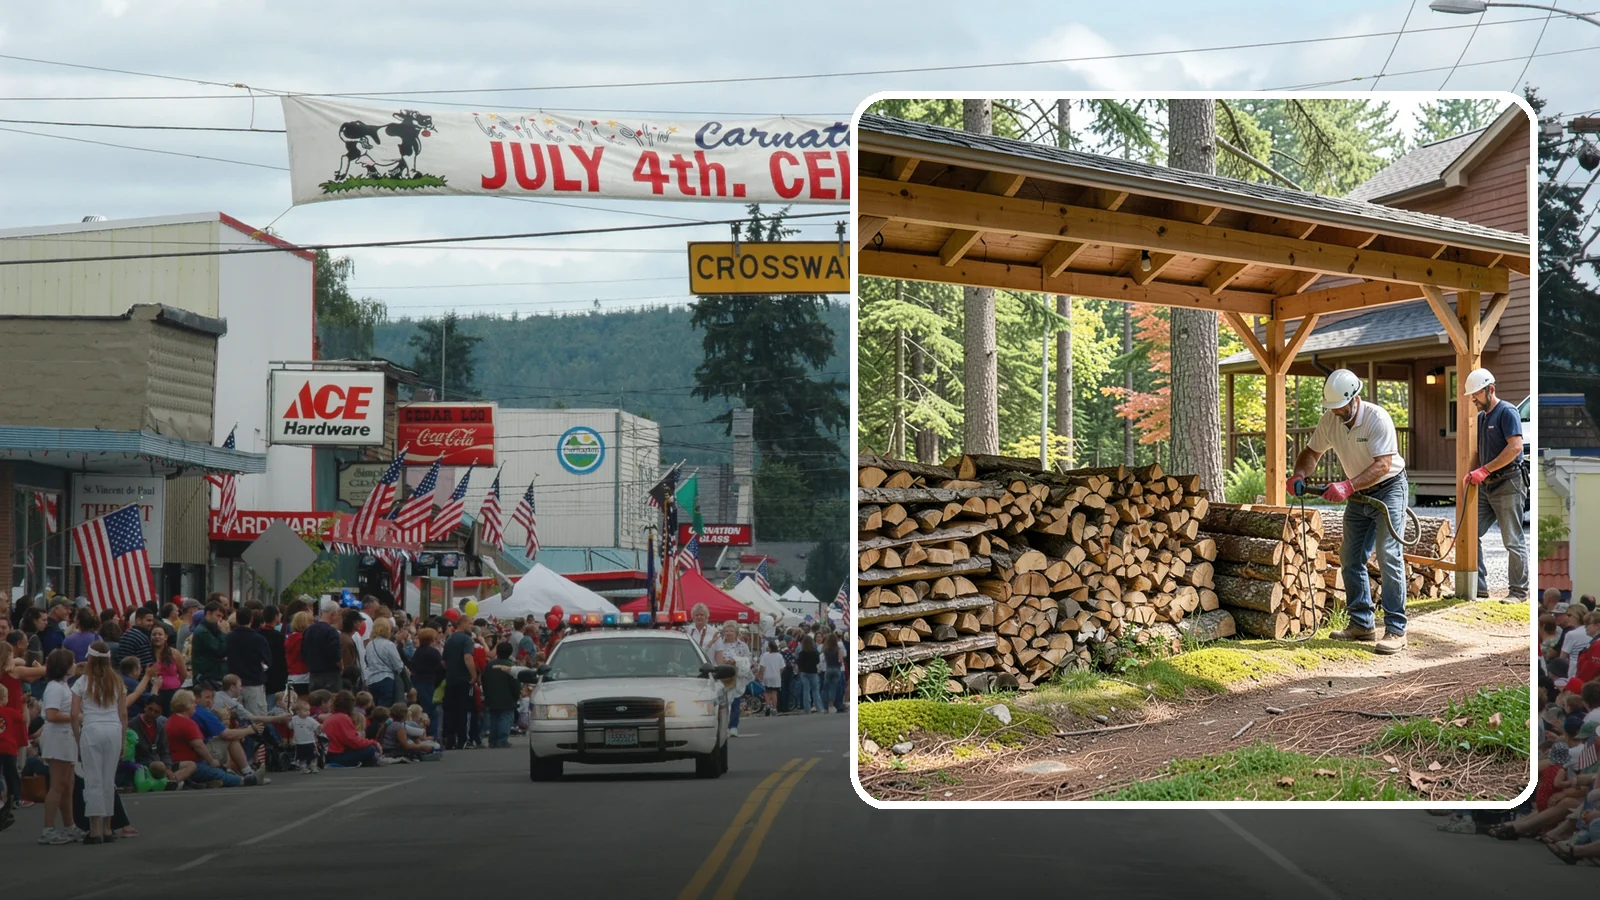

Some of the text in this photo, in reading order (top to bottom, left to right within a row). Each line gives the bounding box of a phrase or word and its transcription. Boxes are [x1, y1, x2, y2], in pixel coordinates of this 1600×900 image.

[481, 141, 605, 193] JULY
[632, 150, 747, 198] 4th.
[697, 254, 850, 280] CROSSWA
[283, 380, 373, 420] ACE
[406, 409, 453, 422] CEDAR
[283, 421, 371, 436] Hardware
[416, 428, 476, 447] Coca-Cola
[353, 467, 385, 480] Simpl
[83, 486, 155, 495] St. Vincent de Paul
[81, 503, 154, 522] THT
[212, 515, 331, 536] HARDARE
[688, 526, 741, 535] CRNATION
[699, 535, 730, 543] GLASS
